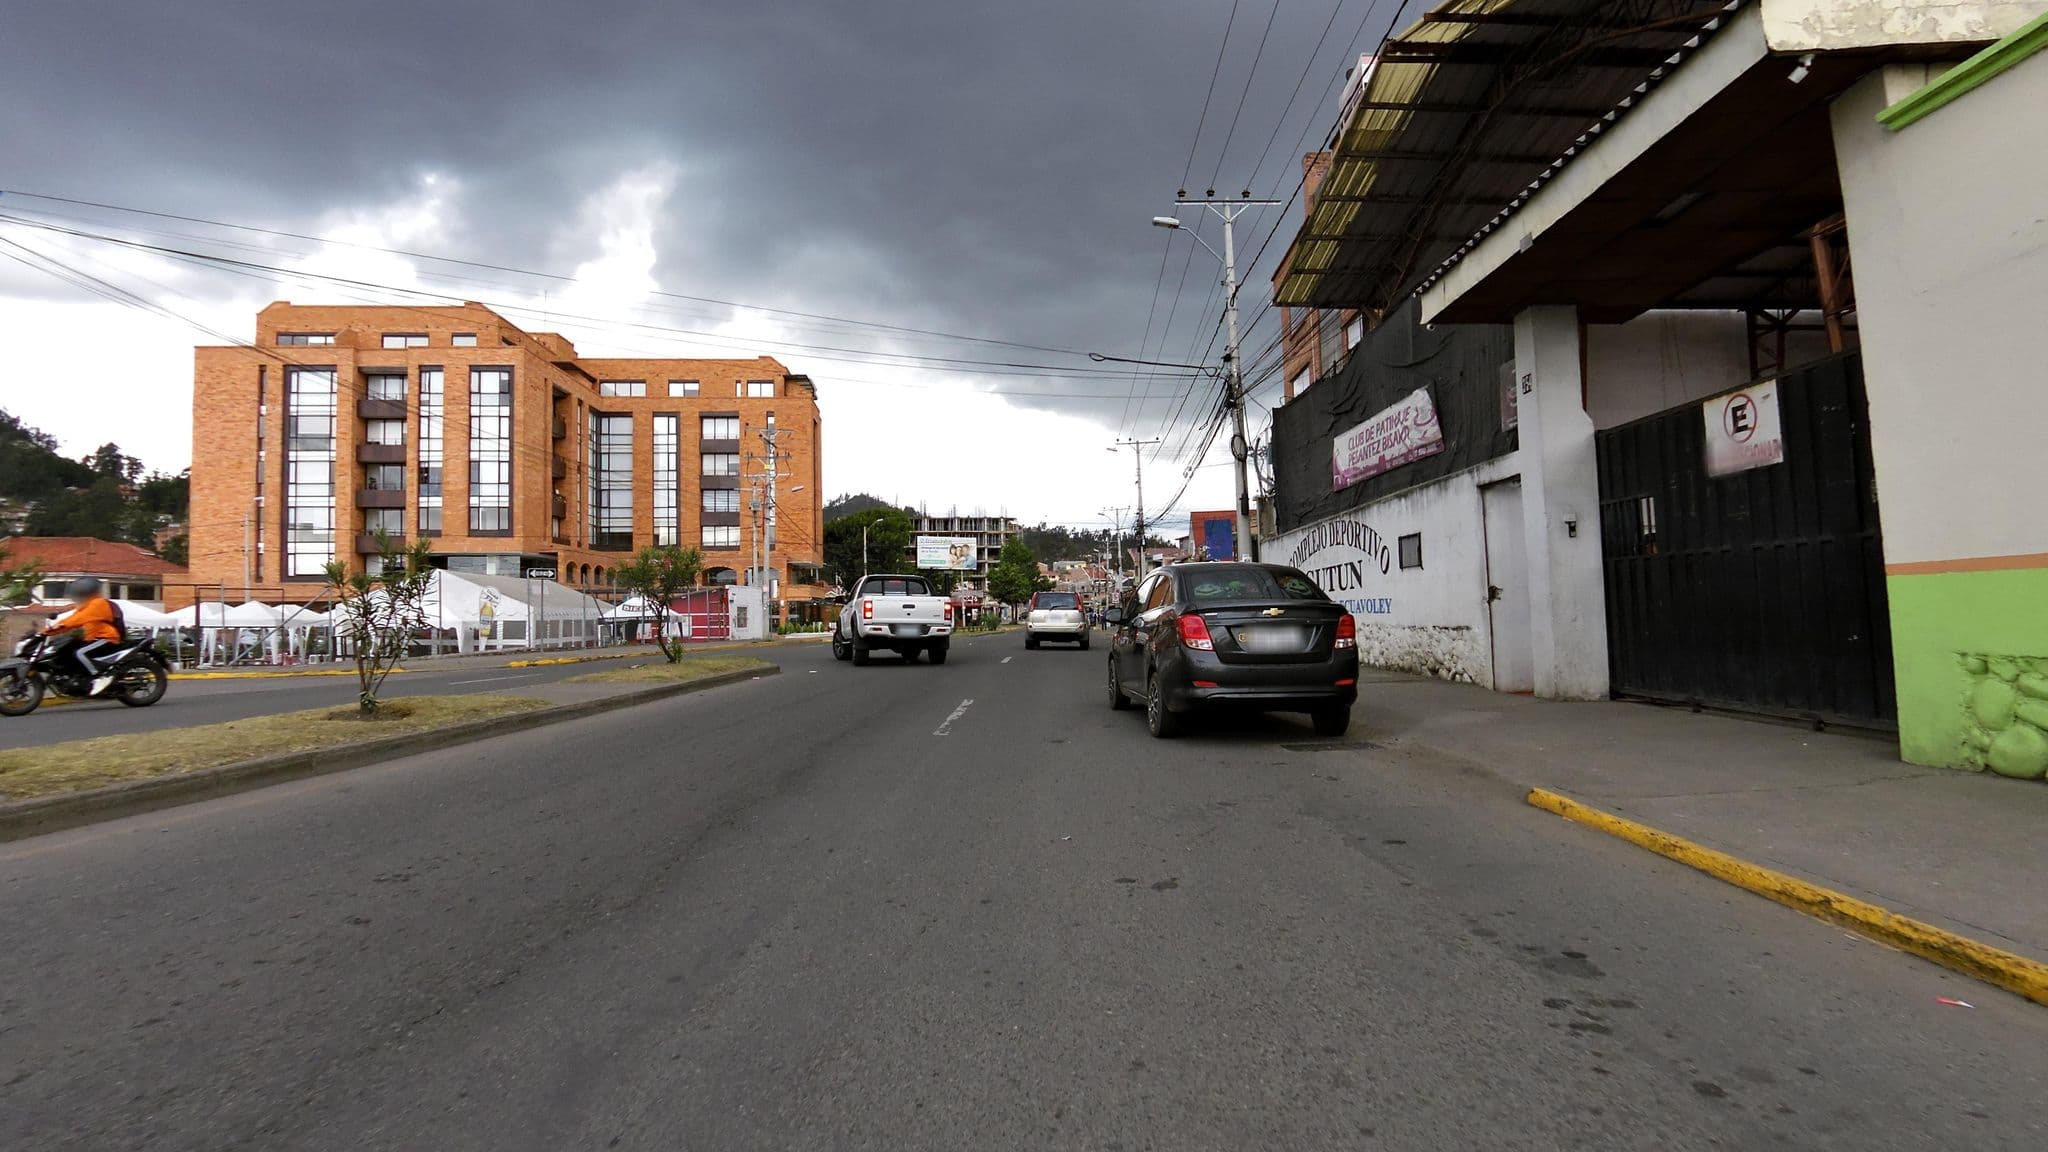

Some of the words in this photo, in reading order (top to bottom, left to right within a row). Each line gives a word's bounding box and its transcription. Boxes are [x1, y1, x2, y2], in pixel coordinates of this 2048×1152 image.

[1731, 403, 1749, 434] E
[1348, 431, 1365, 452] CLUB
[1365, 424, 1375, 443] DE
[1348, 439, 1381, 467] PESANTEZ
[1288, 524, 1328, 569] COMPLEJO
[1328, 519, 1391, 576] DEPORTIVO
[1339, 598, 1393, 614] CUAVOLEY
